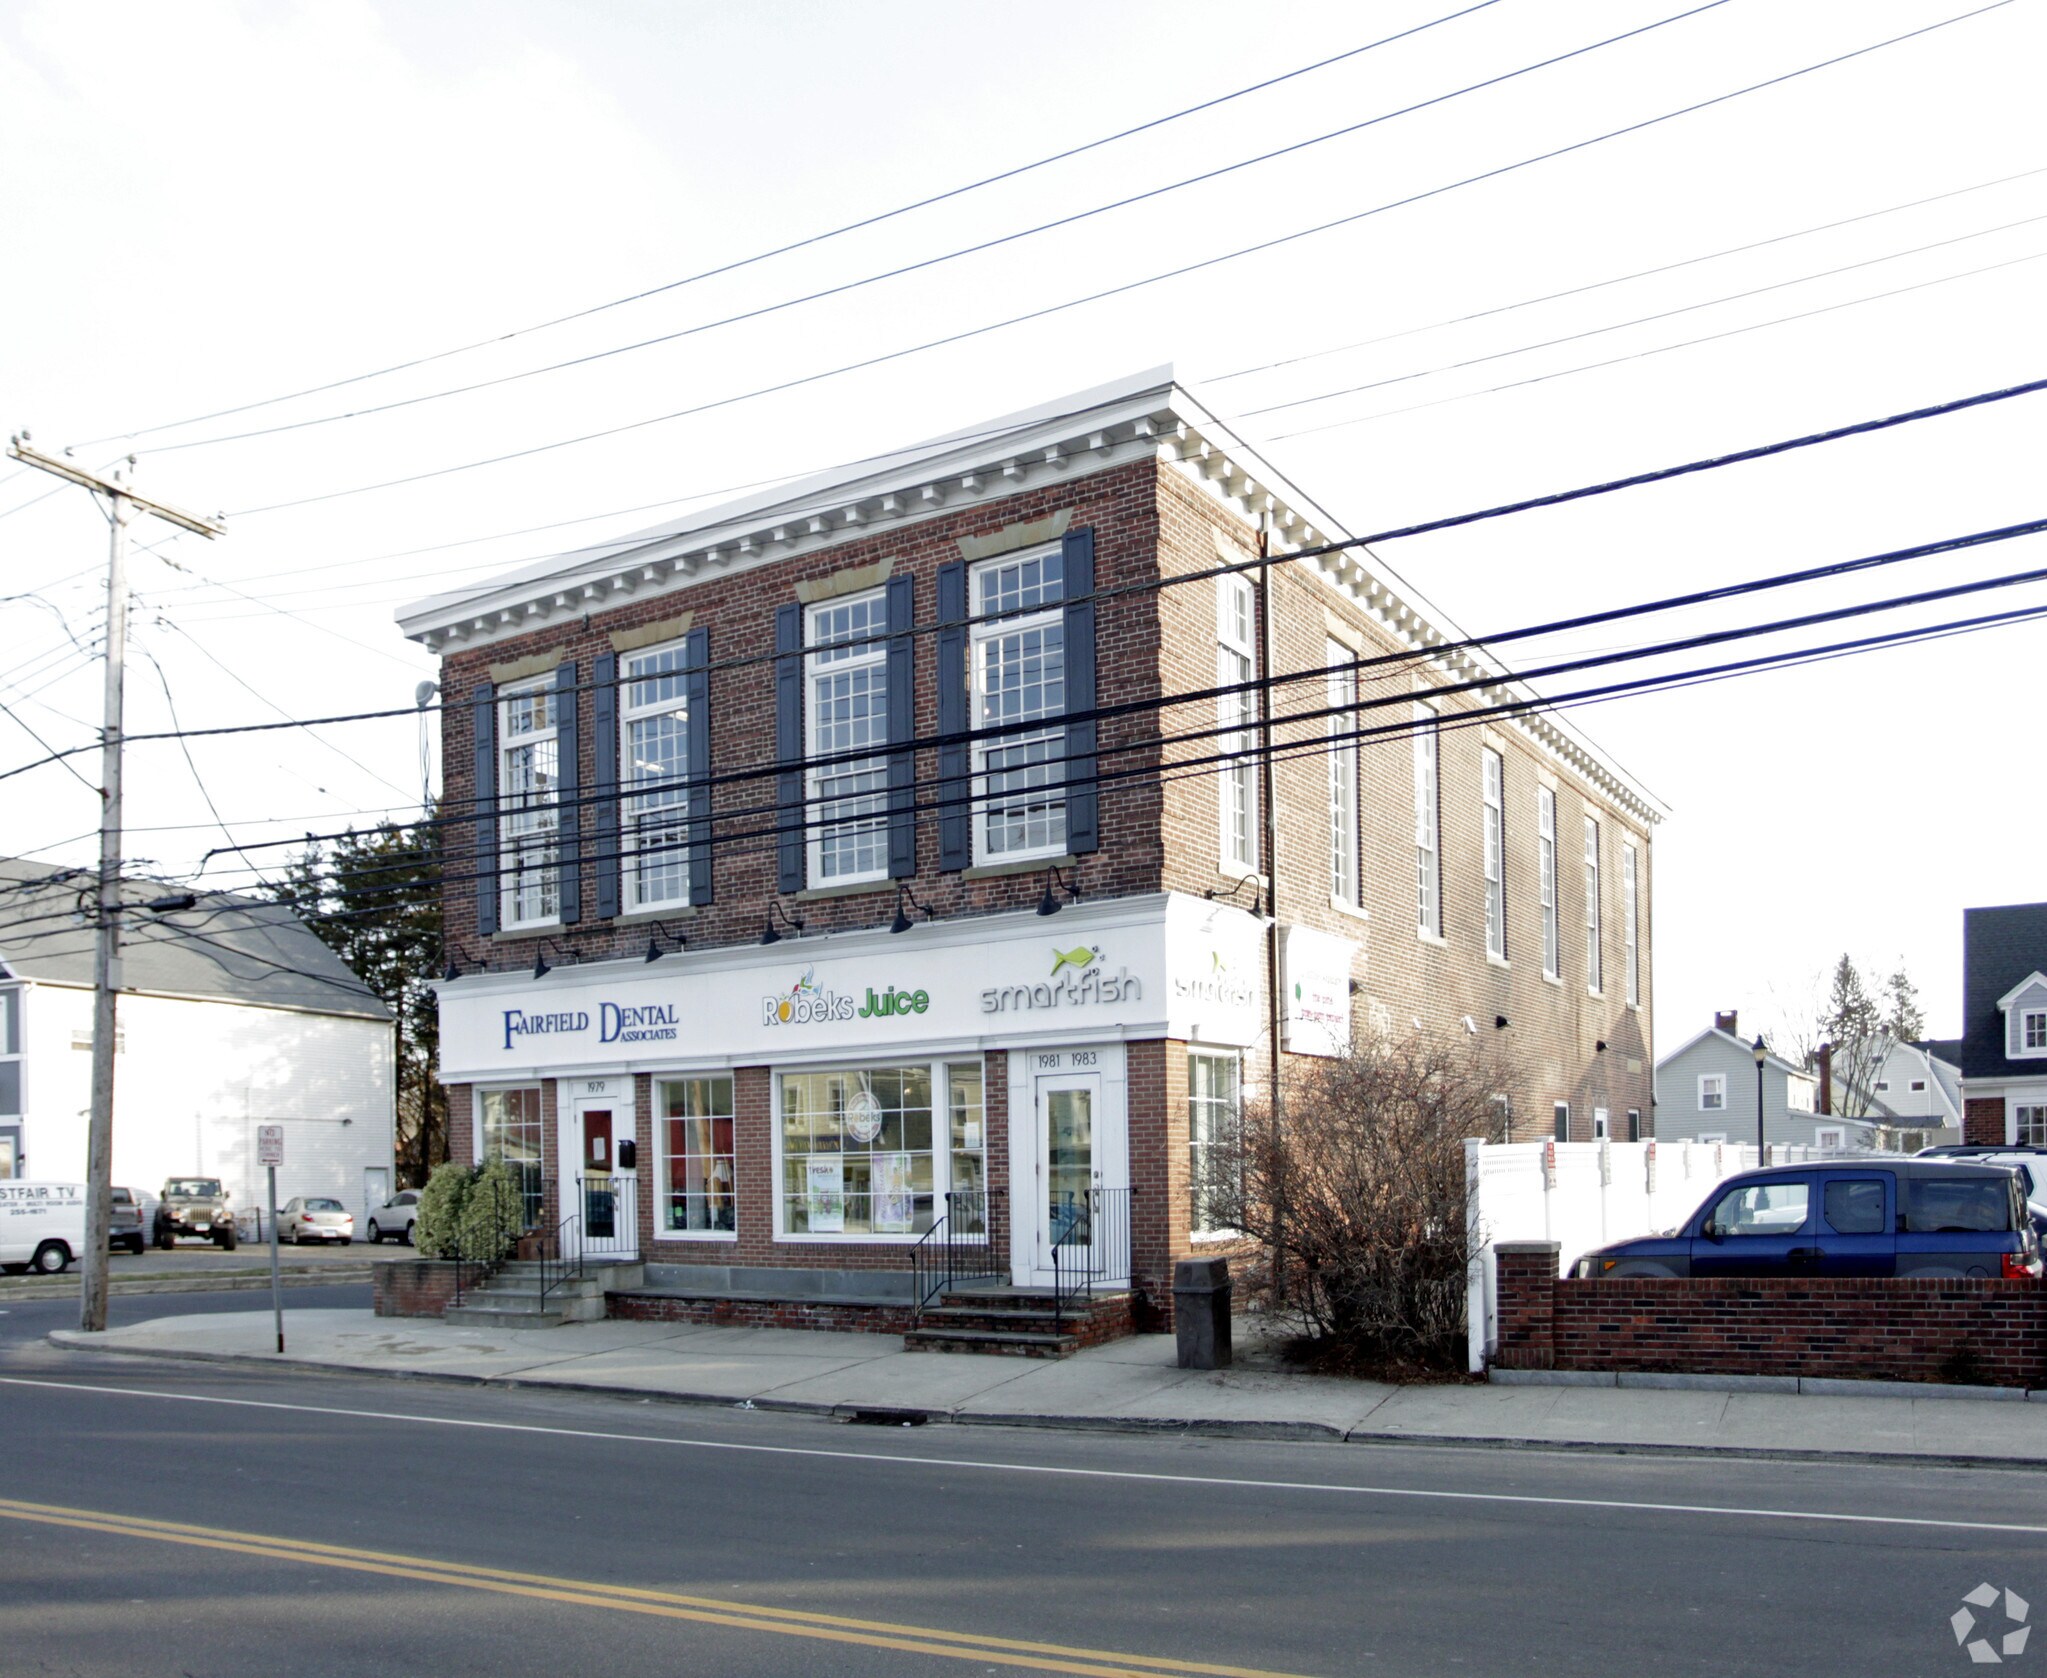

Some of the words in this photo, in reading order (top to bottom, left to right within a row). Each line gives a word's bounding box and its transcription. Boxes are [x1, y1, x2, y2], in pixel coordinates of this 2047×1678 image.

[980, 966, 1142, 1013] smartfish
[762, 991, 854, 1026] Robeks
[858, 985, 929, 1018] Juice
[501, 1009, 589, 1050] FAIRFIELD
[598, 1001, 679, 1043] DENTAL
[620, 1028, 677, 1043] ASSOCIATES
[1038, 1055, 1060, 1068] 1981
[1071, 1052, 1097, 1066] 1983
[587, 1081, 605, 1092] 1979
[56, 1186, 75, 1198] TV
